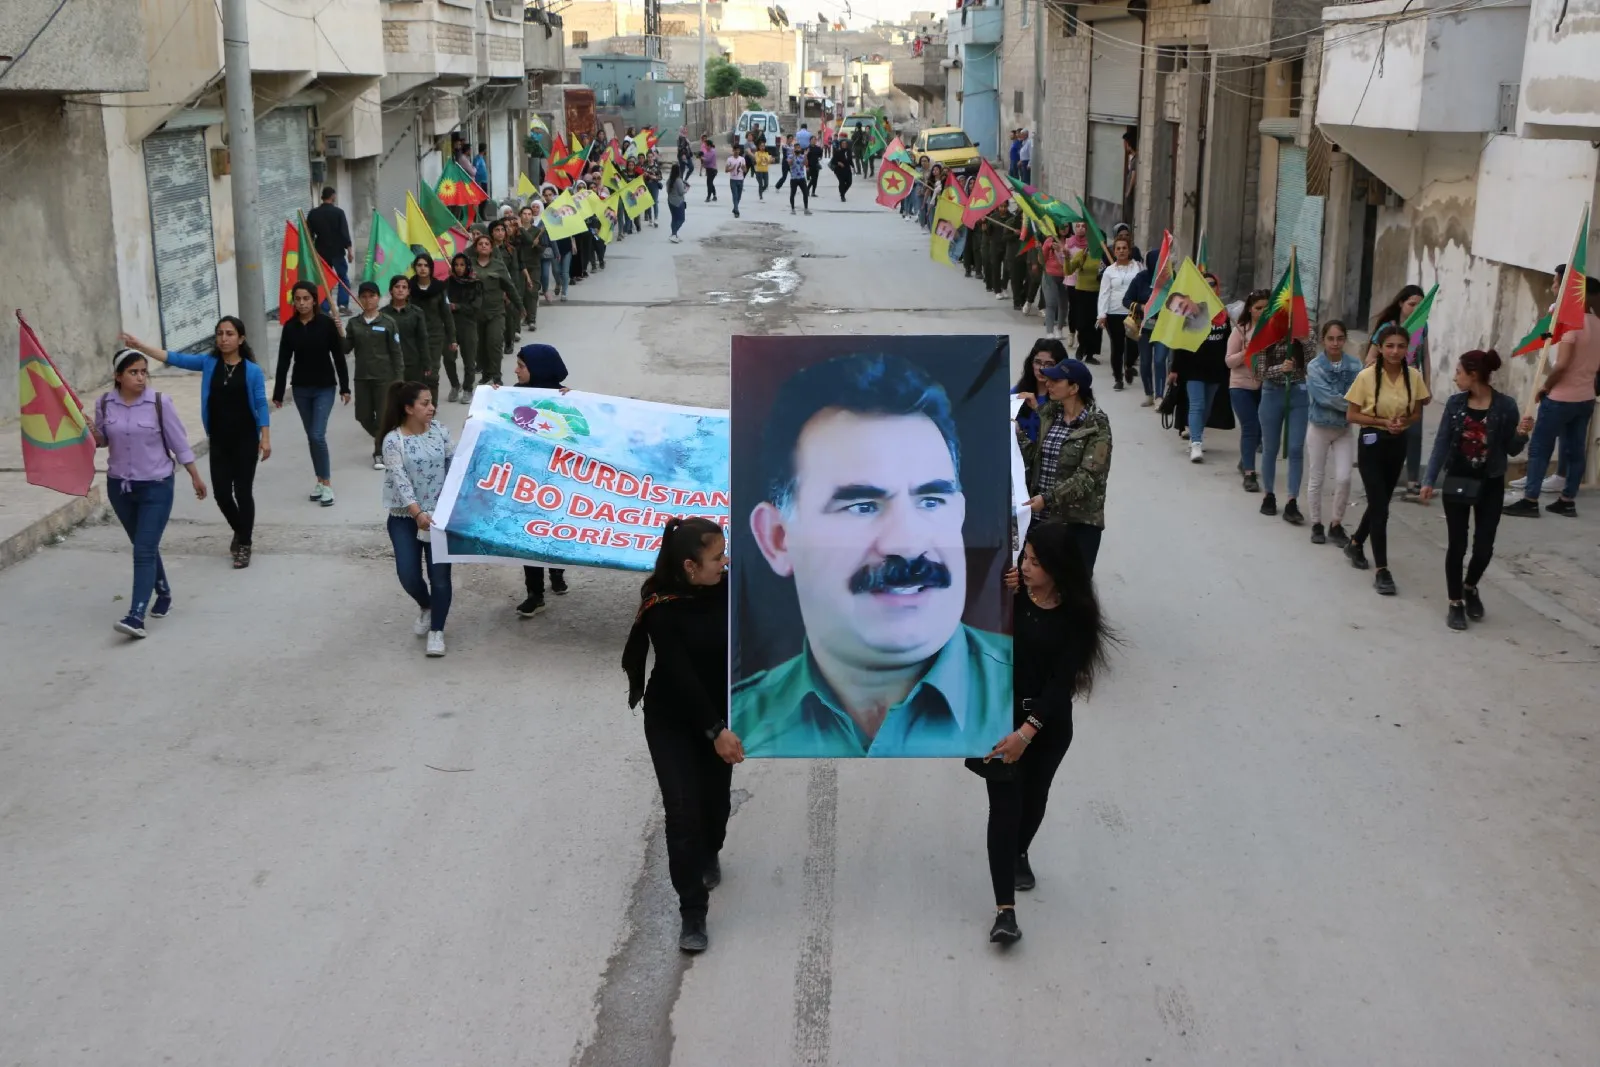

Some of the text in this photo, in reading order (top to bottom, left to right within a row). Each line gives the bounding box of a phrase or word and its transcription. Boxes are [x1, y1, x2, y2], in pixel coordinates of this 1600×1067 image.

[513, 474, 563, 511] BO
[567, 492, 729, 528] DAGİR
[524, 520, 663, 552] GORİSTA
